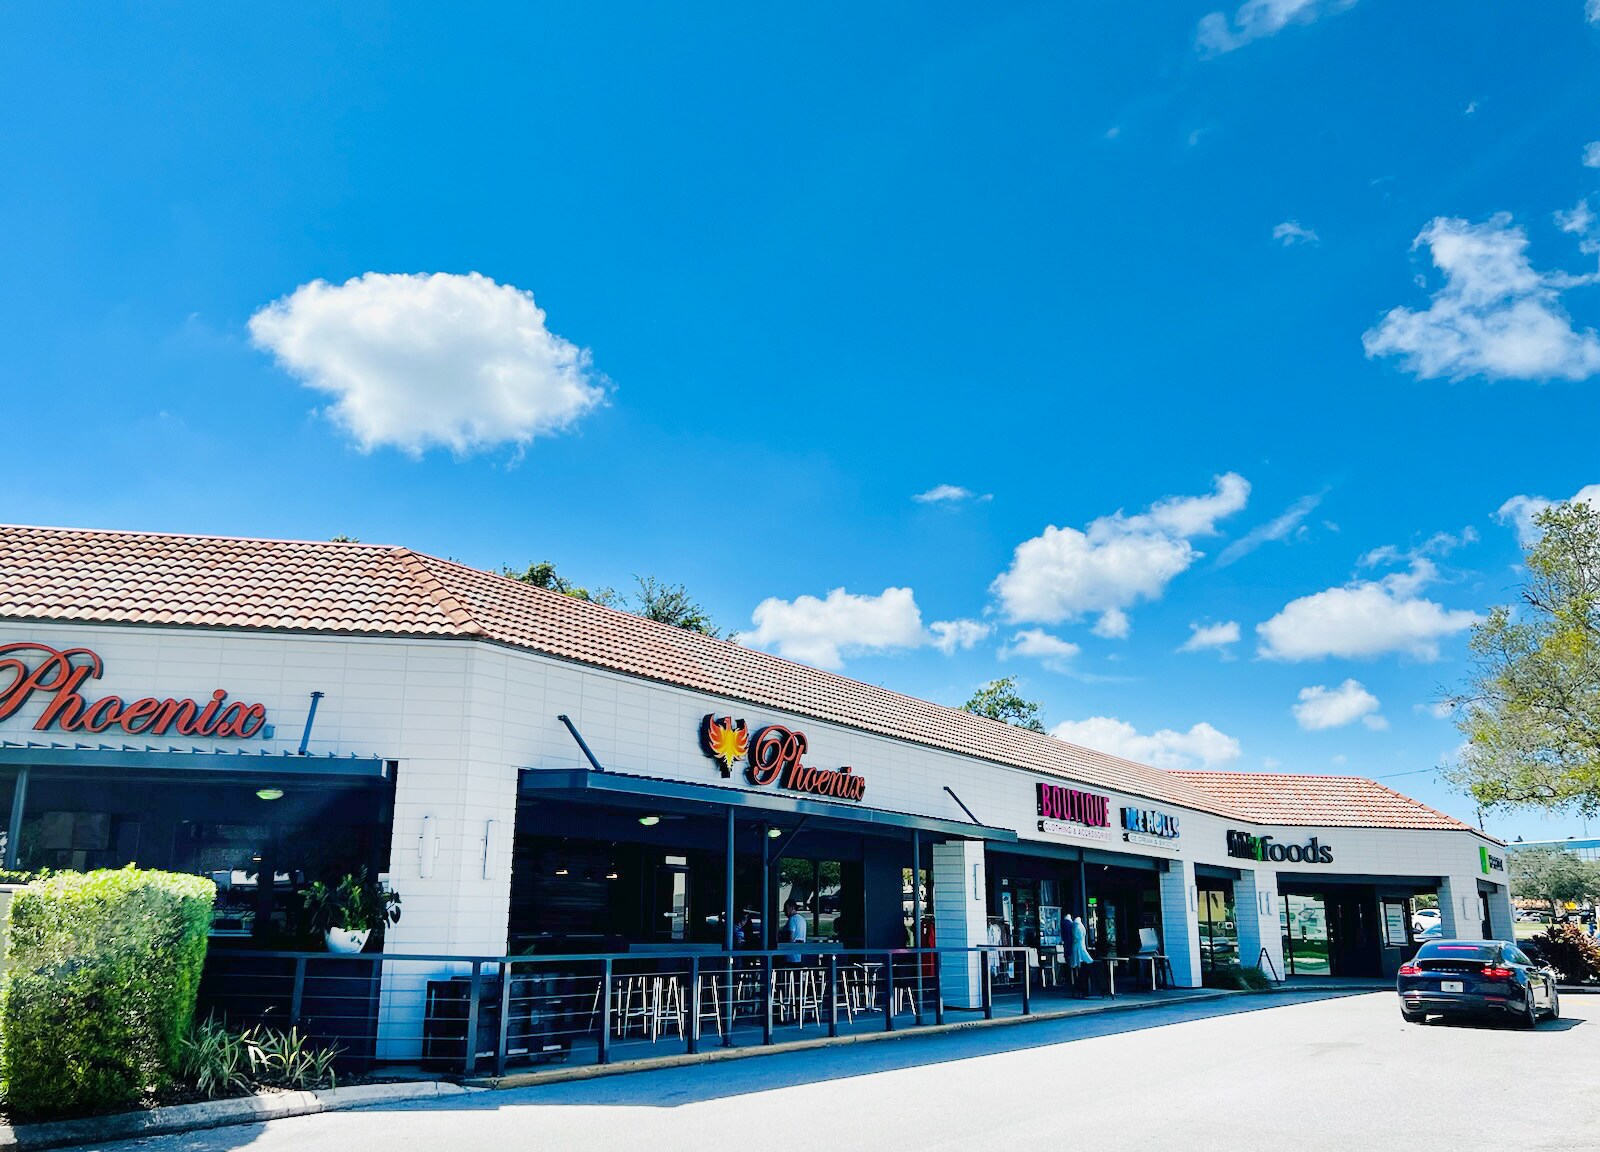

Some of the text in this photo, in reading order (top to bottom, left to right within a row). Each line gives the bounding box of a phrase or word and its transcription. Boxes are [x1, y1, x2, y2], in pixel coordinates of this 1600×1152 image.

[0, 643, 266, 738] Phoenix
[750, 724, 866, 801] Phoenix
[1040, 783, 1111, 828] BOUTIQUE
[1044, 821, 1071, 834] CLOTHING
[1146, 810, 1179, 838] ROLLS
